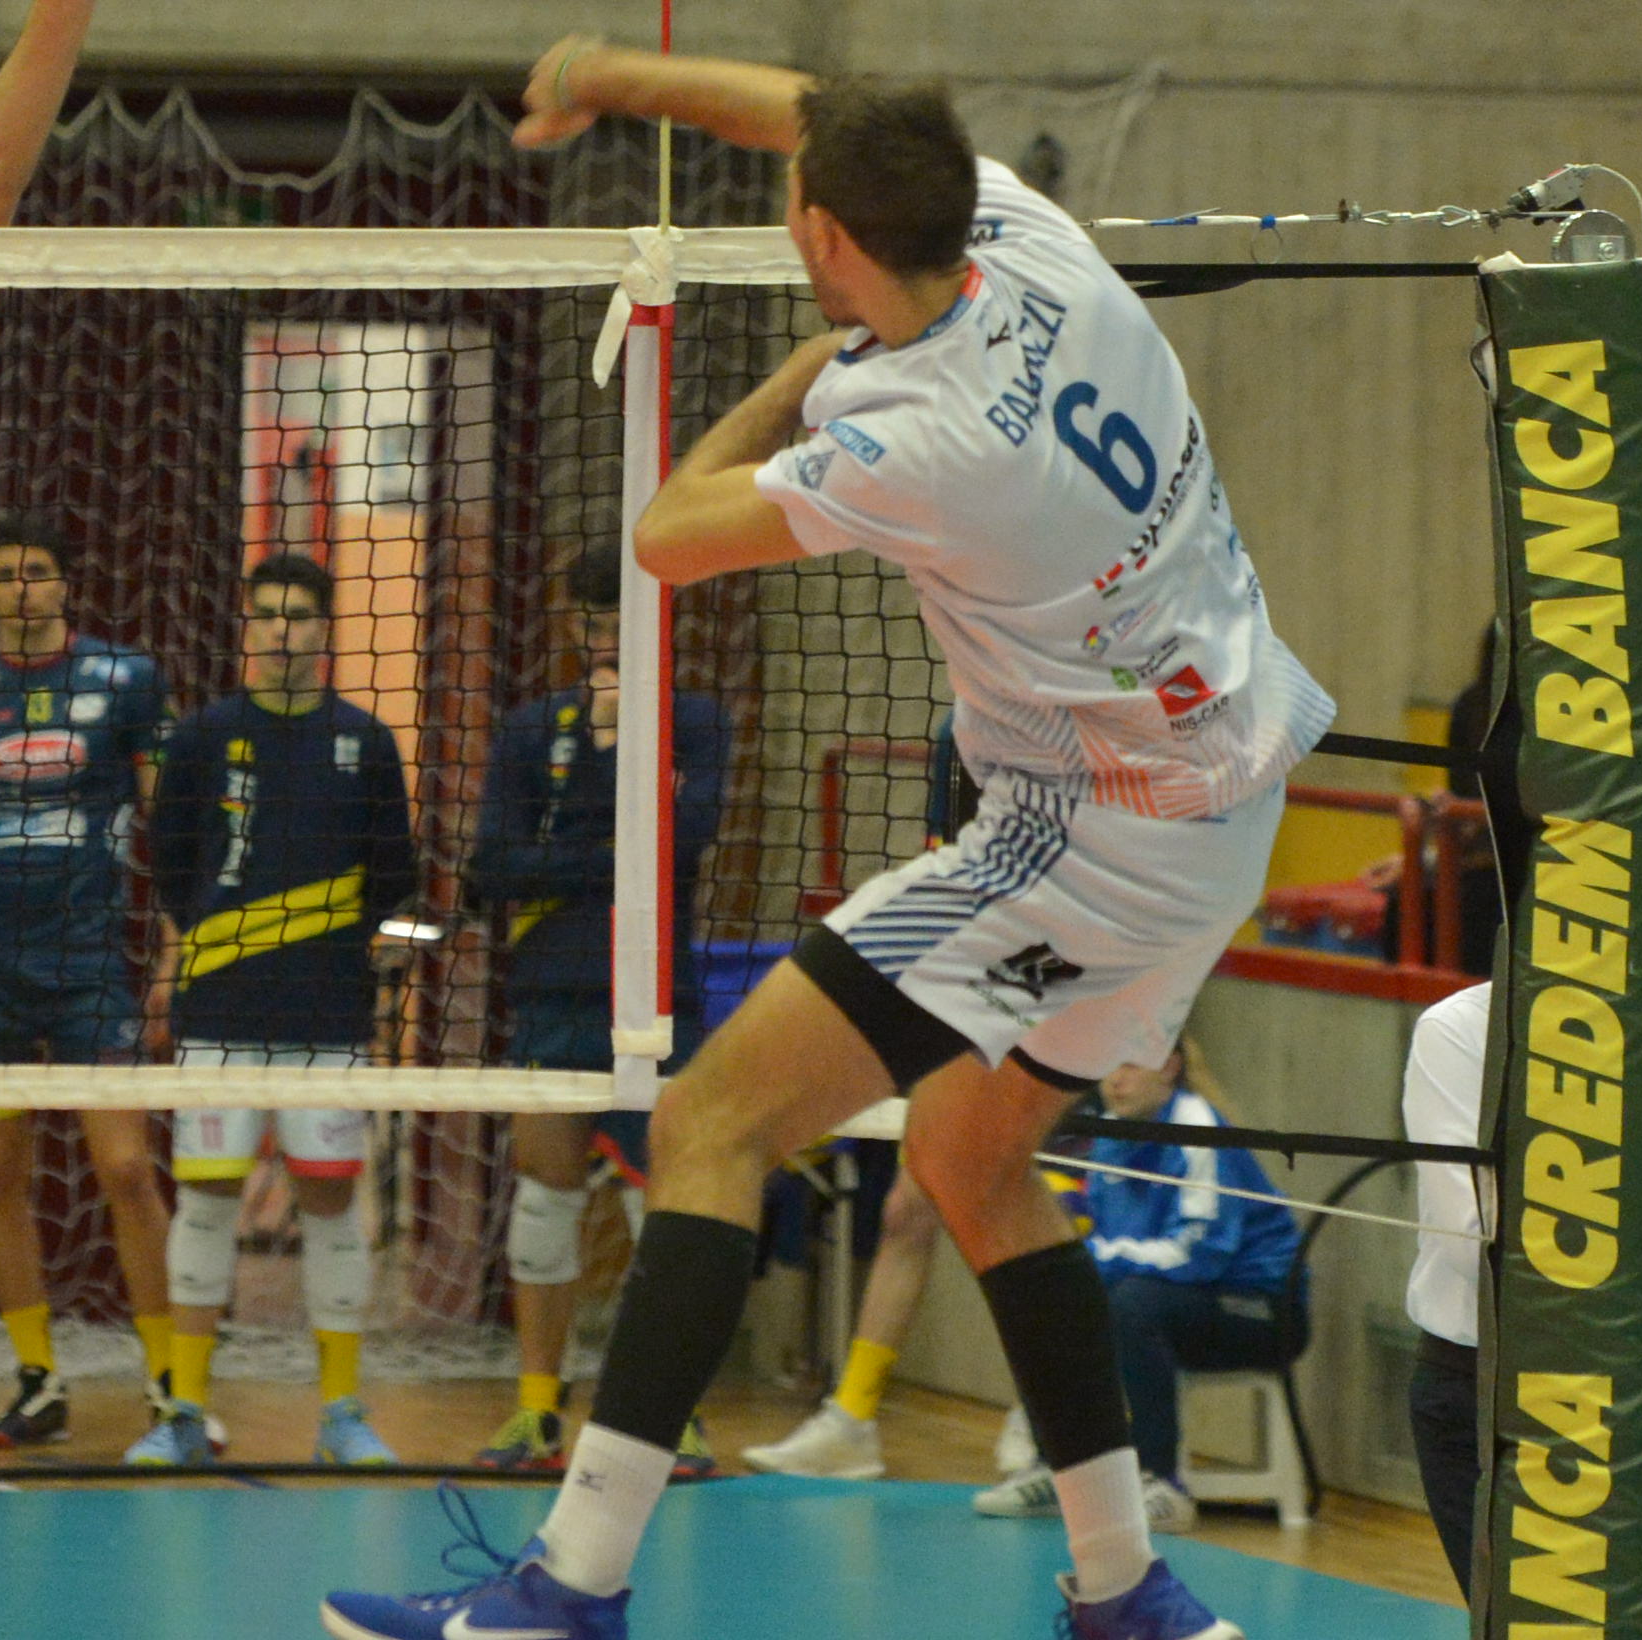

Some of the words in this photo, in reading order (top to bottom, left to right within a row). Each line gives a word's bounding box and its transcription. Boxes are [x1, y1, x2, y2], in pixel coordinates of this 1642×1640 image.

[1052, 381, 1157, 515] 6
[1508, 339, 1635, 758] BANCA
[1520, 814, 1633, 1290] CREDEM
[1508, 1372, 1613, 1640] NCA
